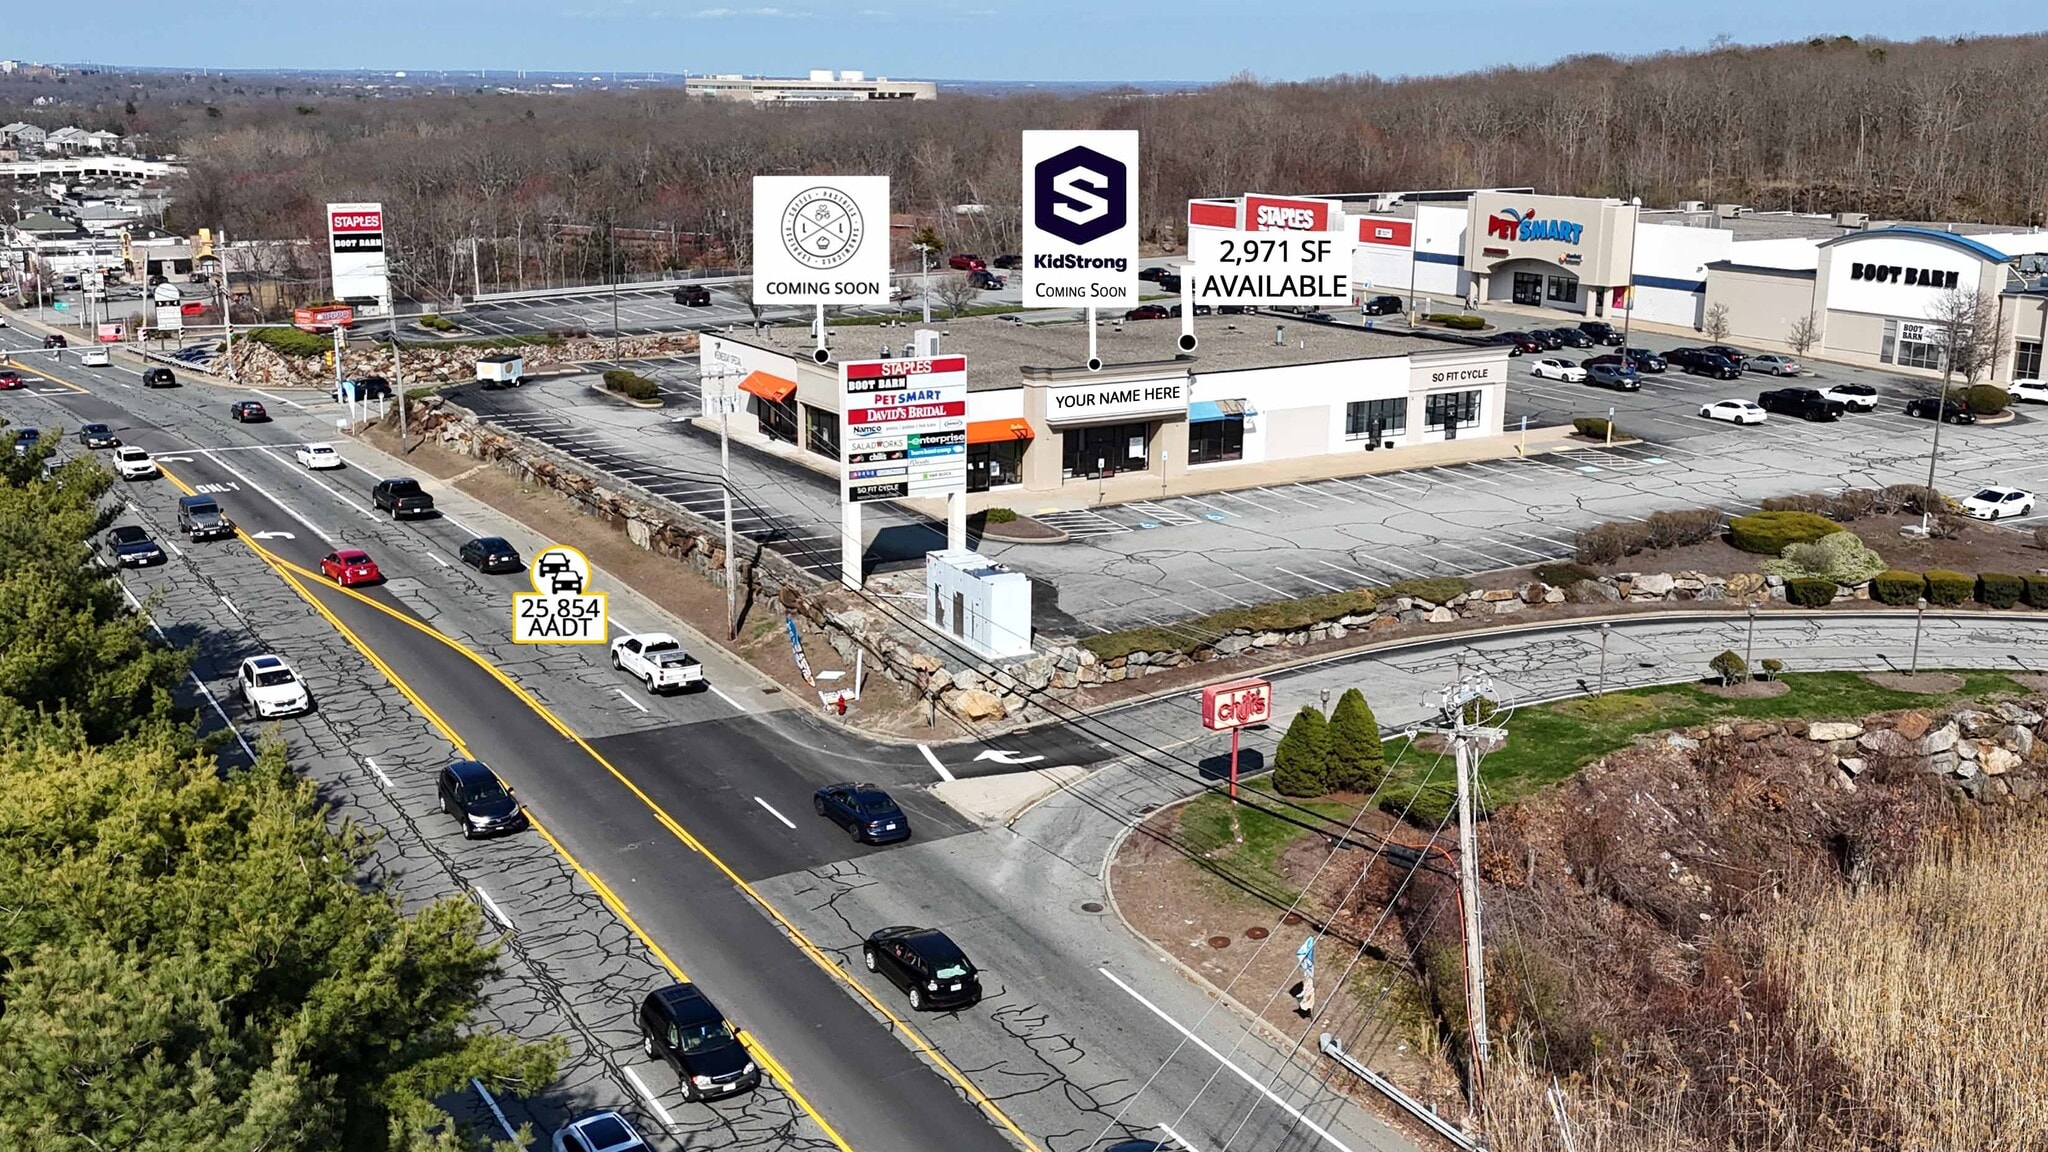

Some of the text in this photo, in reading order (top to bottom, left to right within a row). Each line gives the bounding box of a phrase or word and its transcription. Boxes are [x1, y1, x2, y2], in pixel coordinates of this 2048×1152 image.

[334, 216, 379, 227] STAPLES
[1257, 205, 1314, 230] STAPLES
[359, 239, 382, 247] BARN
[1850, 262, 1959, 289] BOOT BARN
[1903, 323, 1924, 333] BOOT
[1902, 332, 1923, 341] BARN
[881, 361, 932, 376] STAPLES
[1432, 369, 1488, 382] SO FIT CYCLE
[848, 378, 906, 391] BOOT BARN
[867, 405, 947, 422] DAVID'S BRIDAL
[853, 425, 882, 433] Namco
[911, 433, 965, 445] enterprise
[195, 481, 240, 494] ONLY
[878, 484, 899, 492] CYCLE
